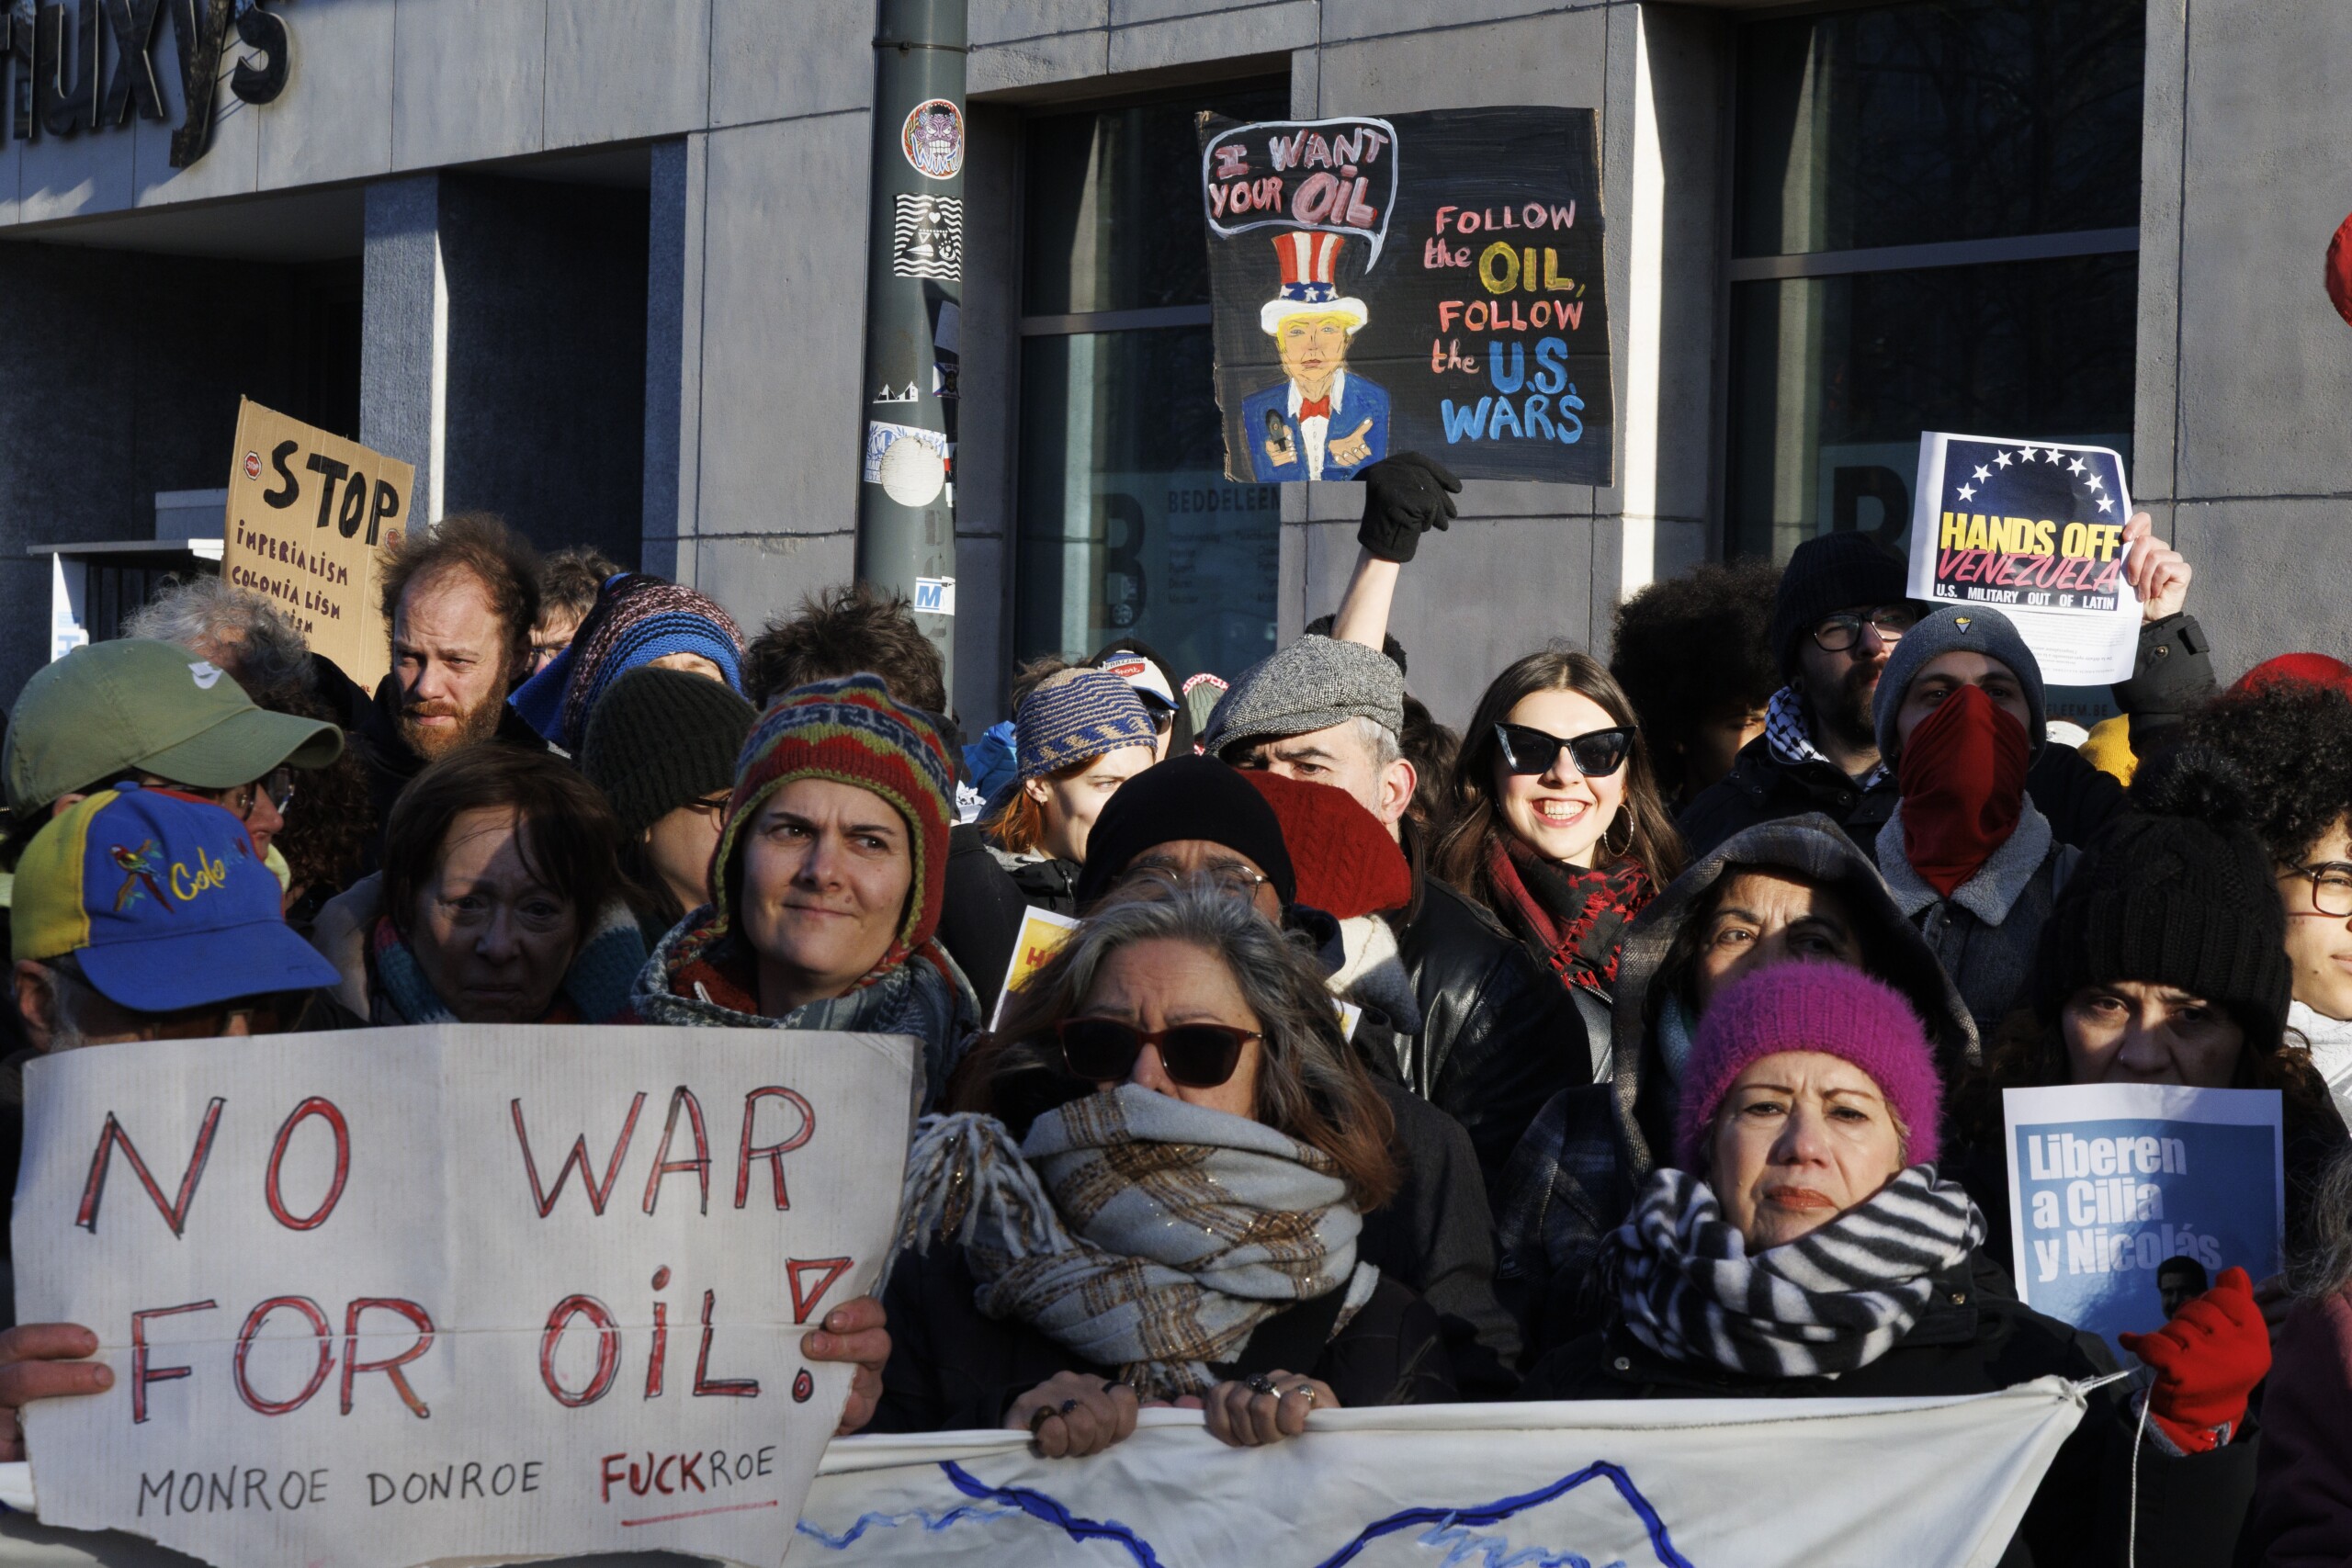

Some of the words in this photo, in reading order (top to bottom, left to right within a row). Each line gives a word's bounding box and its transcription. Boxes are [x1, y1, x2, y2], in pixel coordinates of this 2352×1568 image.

[0, 0, 291, 167] luxys
[1216, 144, 1250, 179] I
[1269, 127, 1389, 172] WANT
[1209, 176, 1283, 219] YOUR
[1435, 199, 1576, 235] FOLLOW
[1424, 237, 1472, 269] the
[1479, 241, 1586, 297] OIL,
[1439, 299, 1583, 333] FOLLOW
[1431, 339, 1480, 373] the
[1489, 336, 1577, 393] U.S.
[1441, 395, 1585, 445] WARS
[263, 440, 400, 547] STOP
[1940, 512, 2056, 558] HANDS
[2061, 521, 2122, 562] OFF
[1938, 545, 2121, 592] VENEZUELA
[1936, 583, 1958, 599] U.S.
[1967, 587, 2019, 604] MILITARY
[2027, 592, 2050, 607] OUT
[2059, 593, 2074, 608] OF
[2082, 595, 2115, 611] LATIN
[75, 1096, 350, 1240] NO
[512, 1085, 816, 1218] WAR
[2028, 1133, 2188, 1181] Liberen
[2031, 1189, 2061, 1230] a
[2066, 1177, 2165, 1228] Cilia
[2033, 1239, 2060, 1283] y
[2066, 1223, 2223, 1275] Nicolás
[131, 1295, 435, 1424] FOR
[138, 1465, 330, 1517] MONROE
[368, 1461, 543, 1506] DONROE
[601, 1446, 777, 1503] FUCKROE
